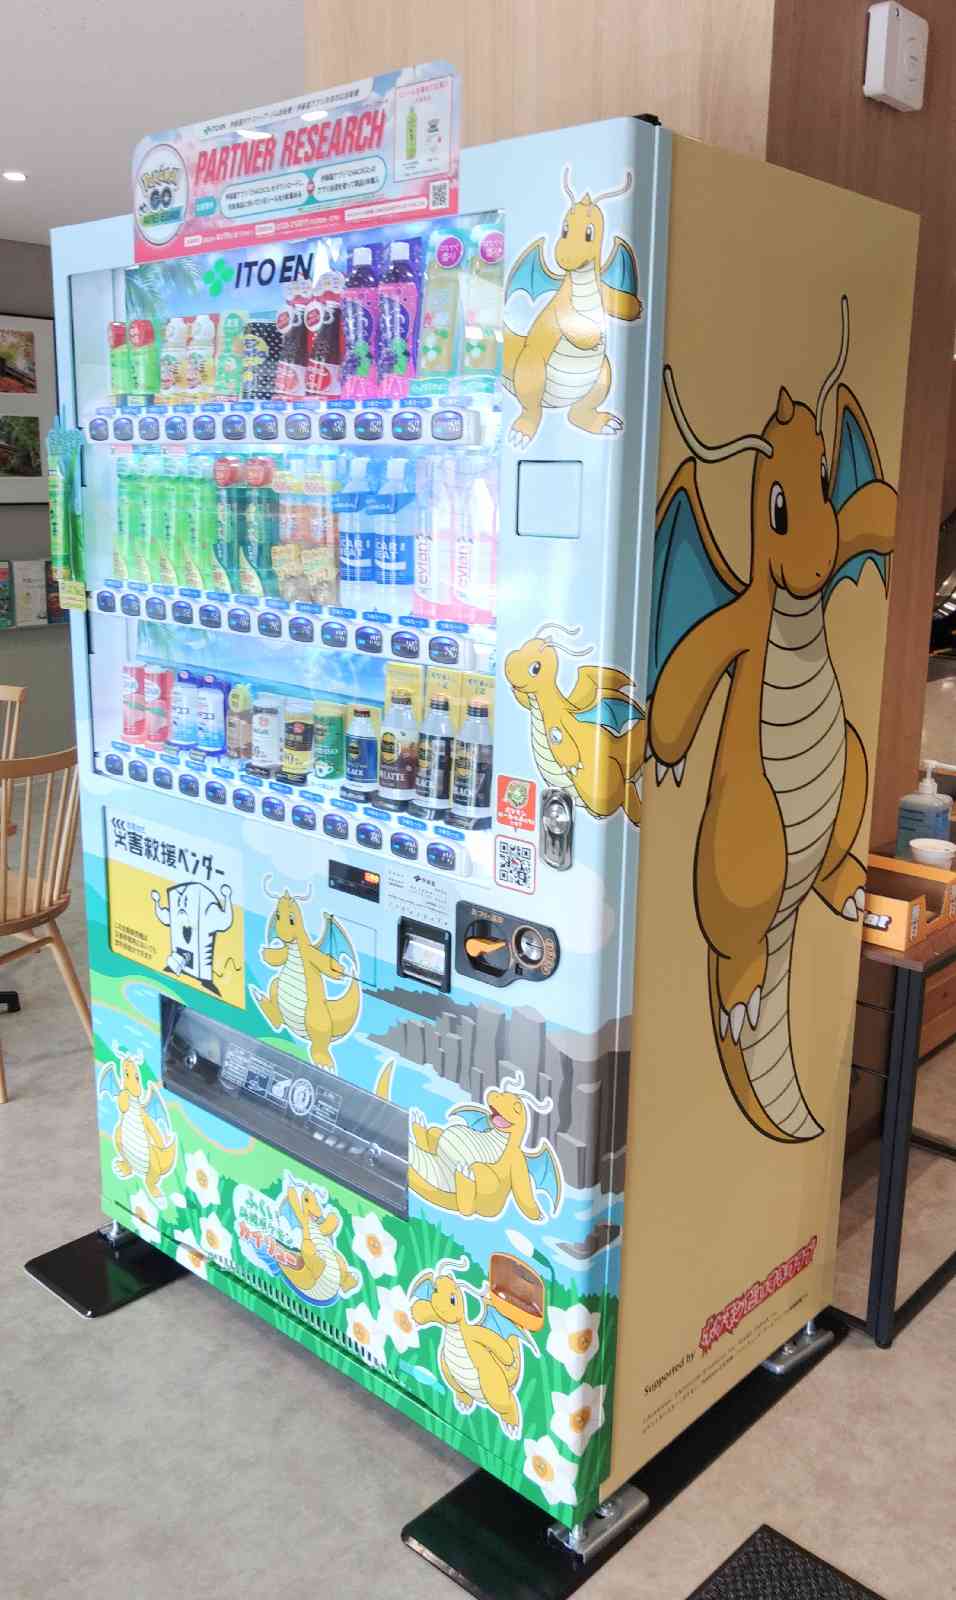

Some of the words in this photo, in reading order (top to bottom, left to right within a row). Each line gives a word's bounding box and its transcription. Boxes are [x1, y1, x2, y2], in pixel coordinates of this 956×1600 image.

[193, 134, 277, 186] PARTNER
[280, 109, 386, 168] RESEARCH
[235, 258, 276, 289] ITO
[279, 252, 314, 283] EN
